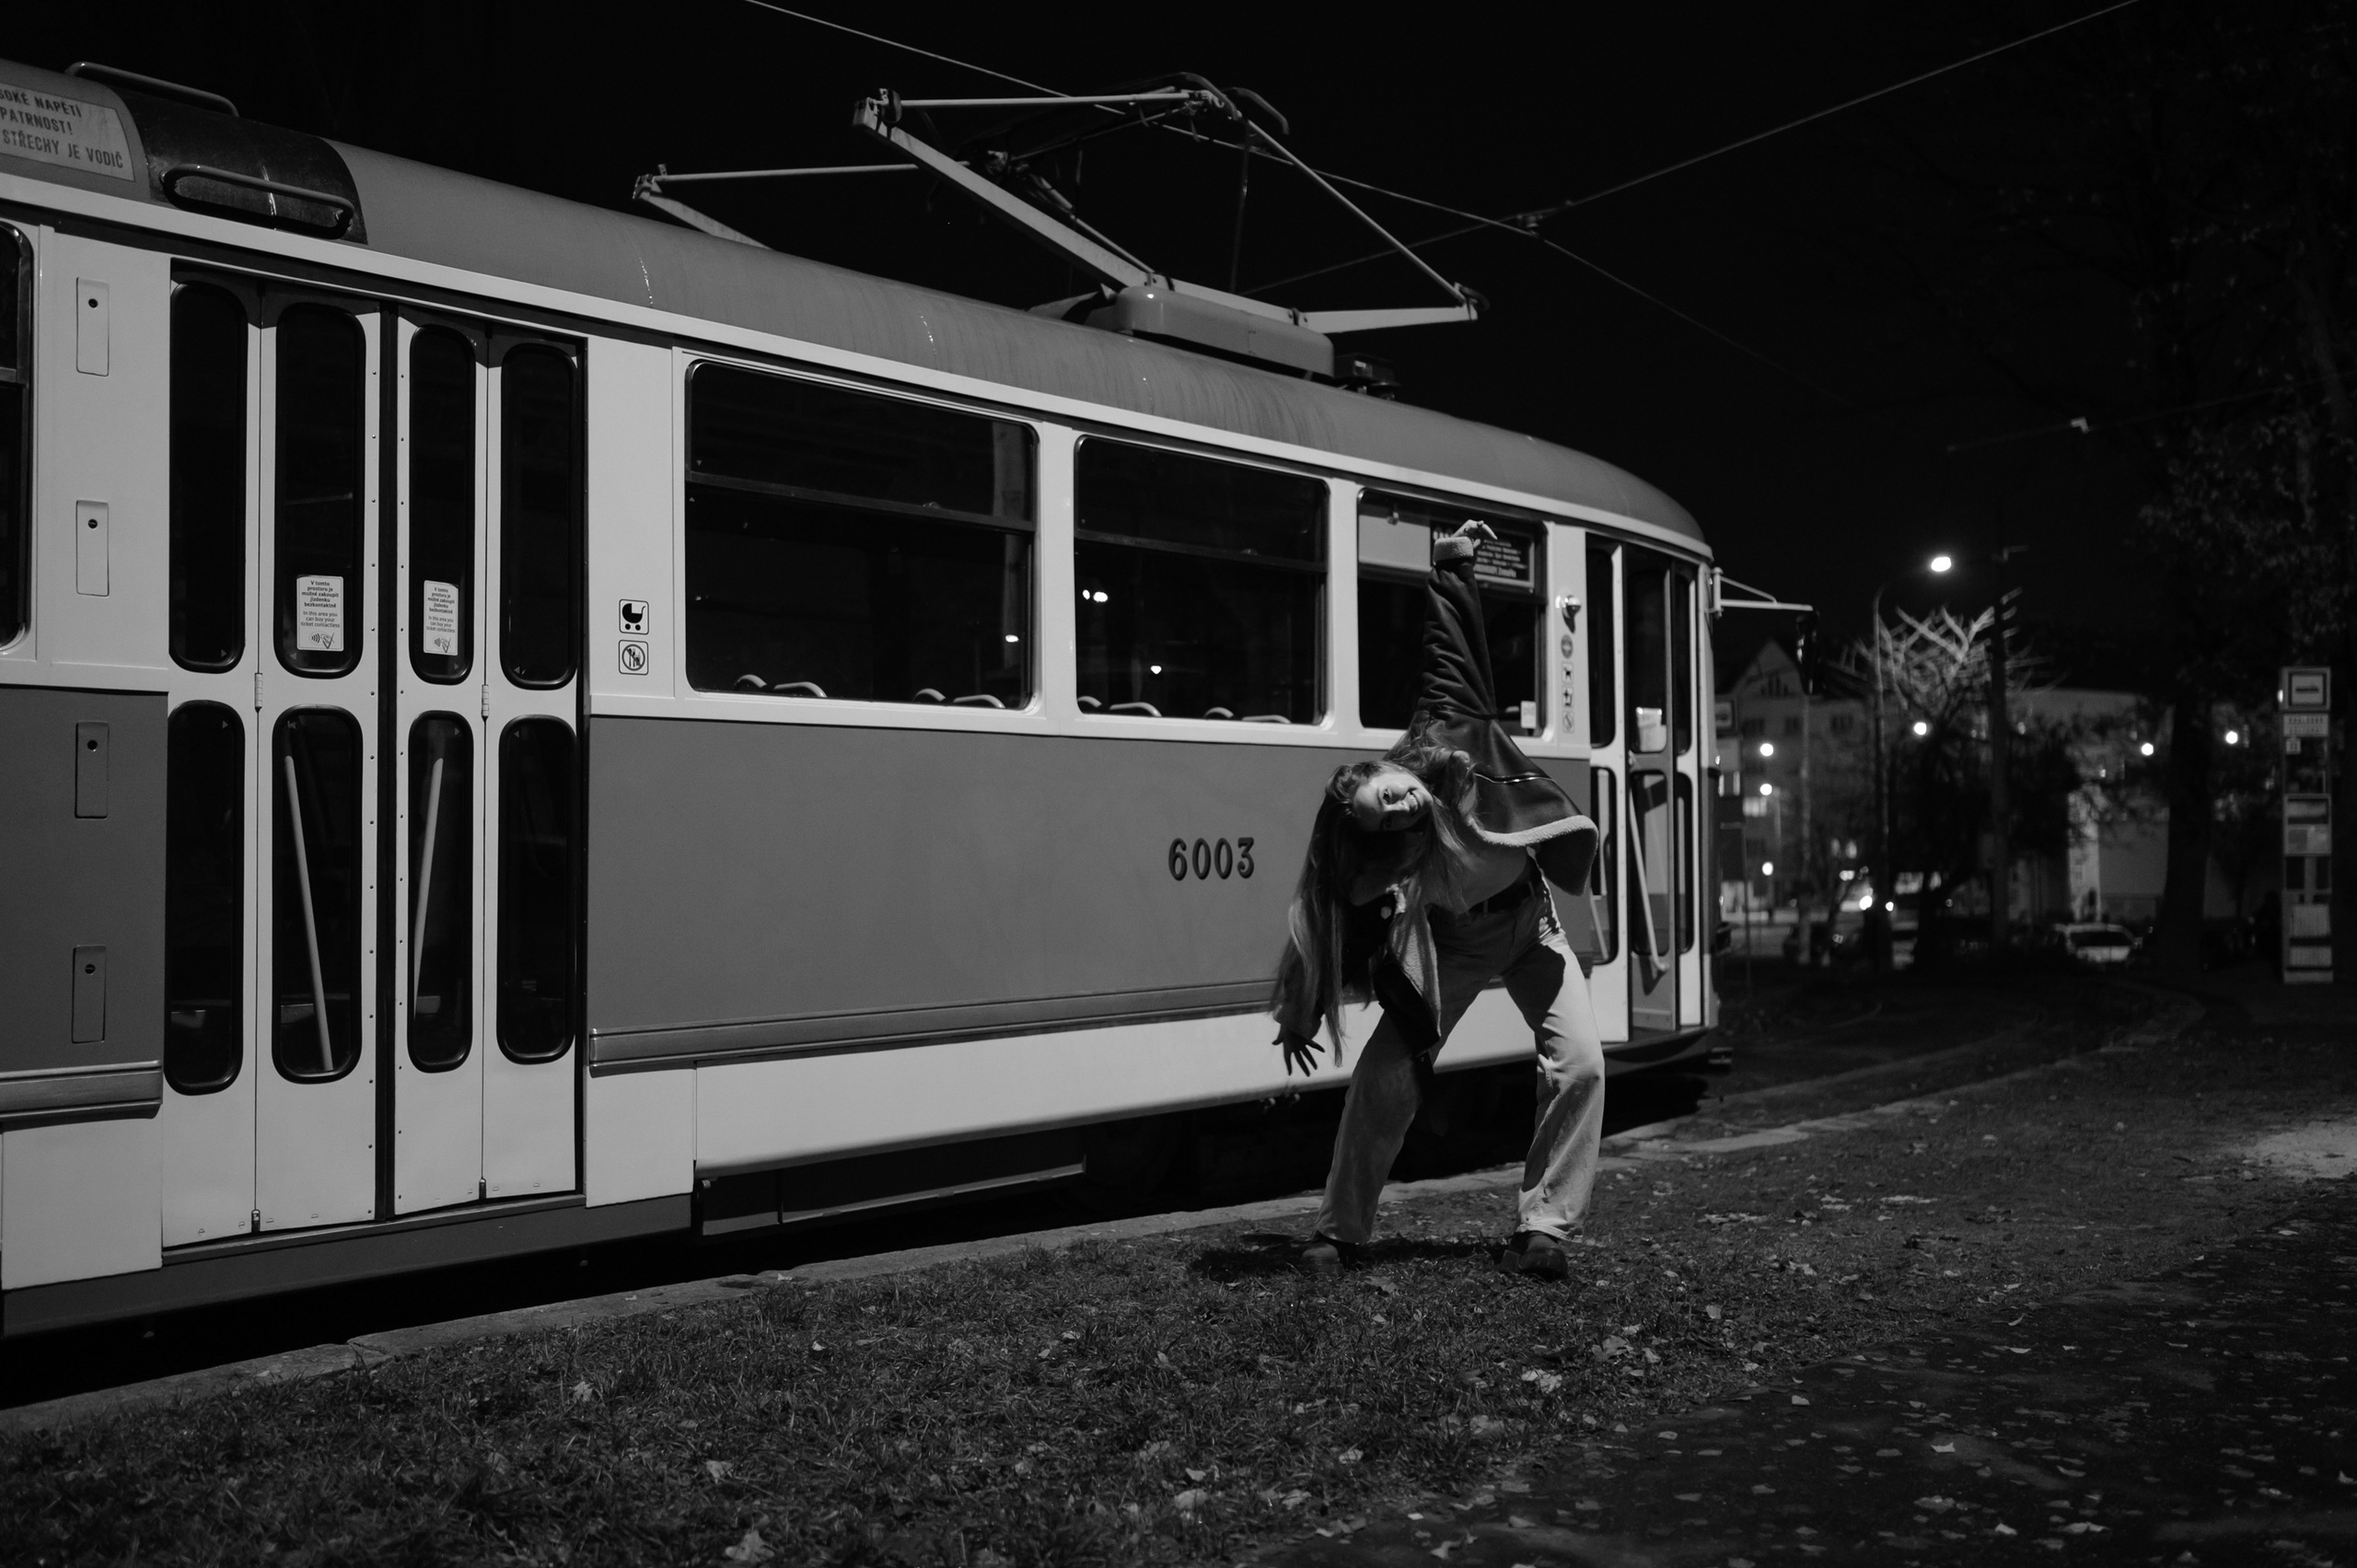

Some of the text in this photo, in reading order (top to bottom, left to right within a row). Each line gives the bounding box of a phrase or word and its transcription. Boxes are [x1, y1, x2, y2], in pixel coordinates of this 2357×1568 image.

[2, 129, 123, 168] STŘECHY JE VODIČ
[1168, 837, 1255, 881] 6003
